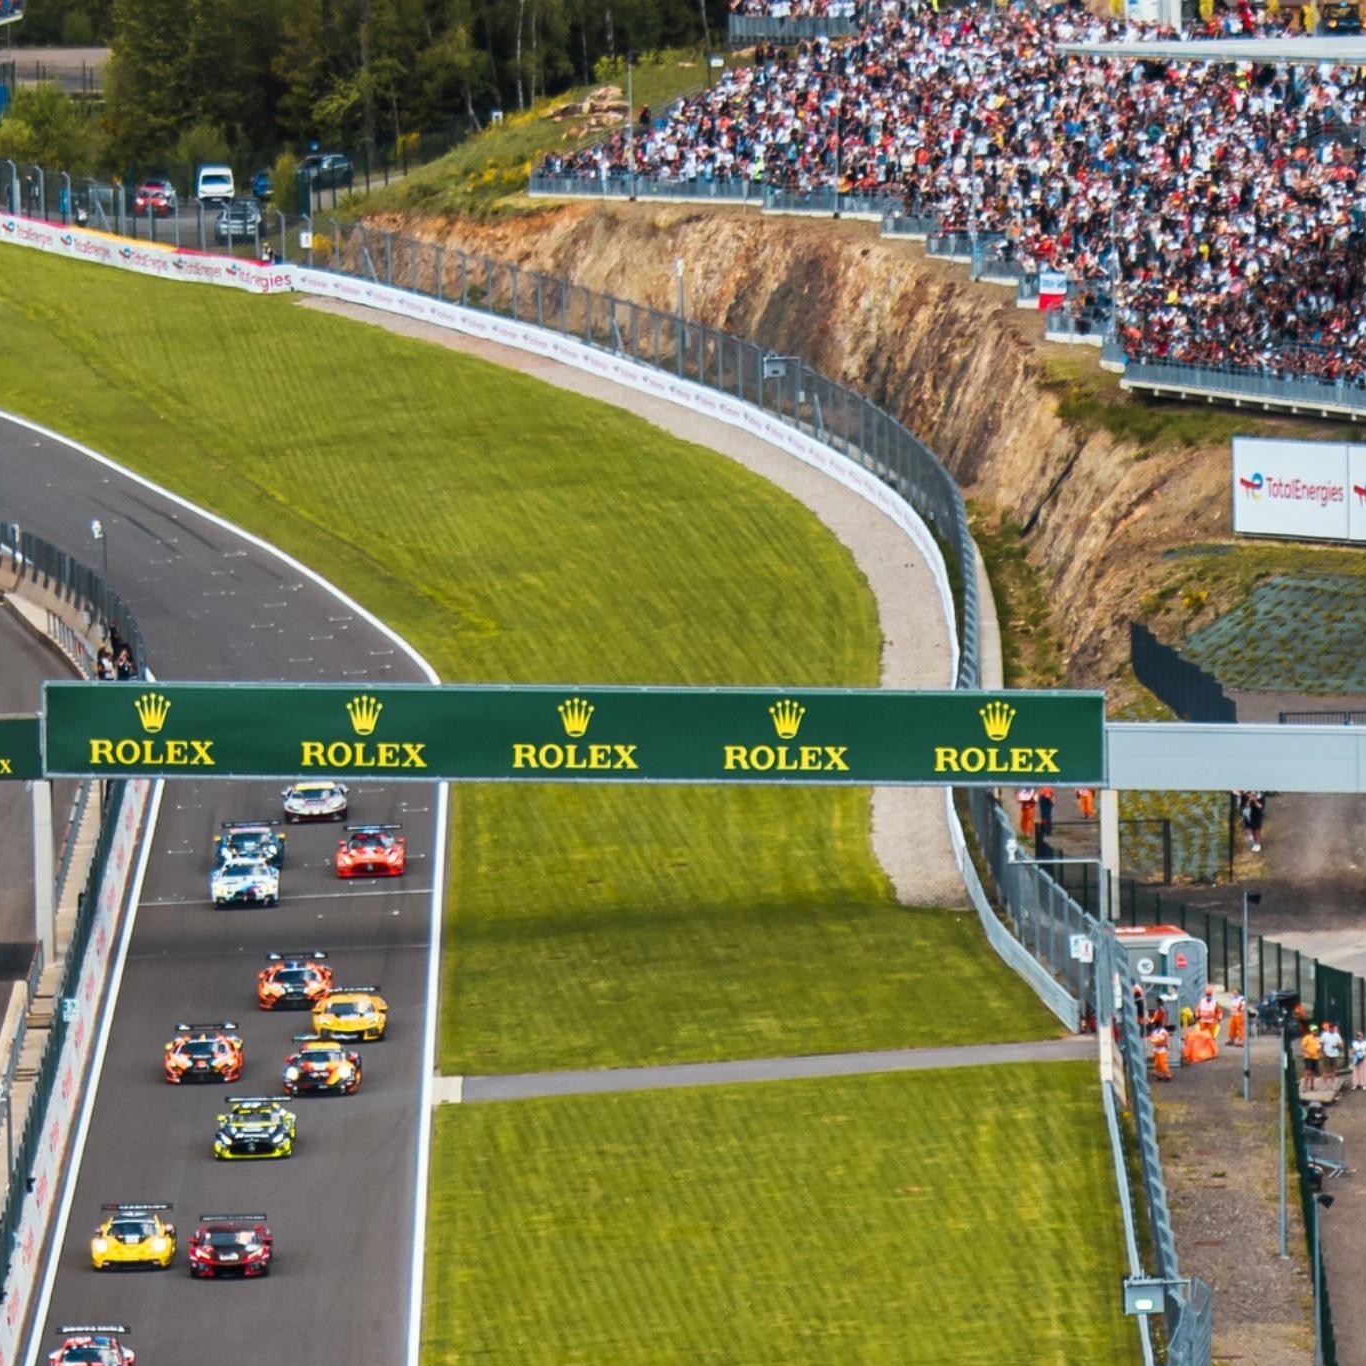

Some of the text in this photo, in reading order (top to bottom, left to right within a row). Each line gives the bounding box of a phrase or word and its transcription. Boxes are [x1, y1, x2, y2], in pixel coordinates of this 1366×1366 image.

[1266, 477, 1345, 508] TotalEnergies
[89, 740, 216, 766] ROLEX
[301, 742, 427, 768] ROLEX
[512, 744, 639, 770] ROLEX
[724, 746, 849, 772] ROLEX
[934, 747, 1060, 774] ROLEX
